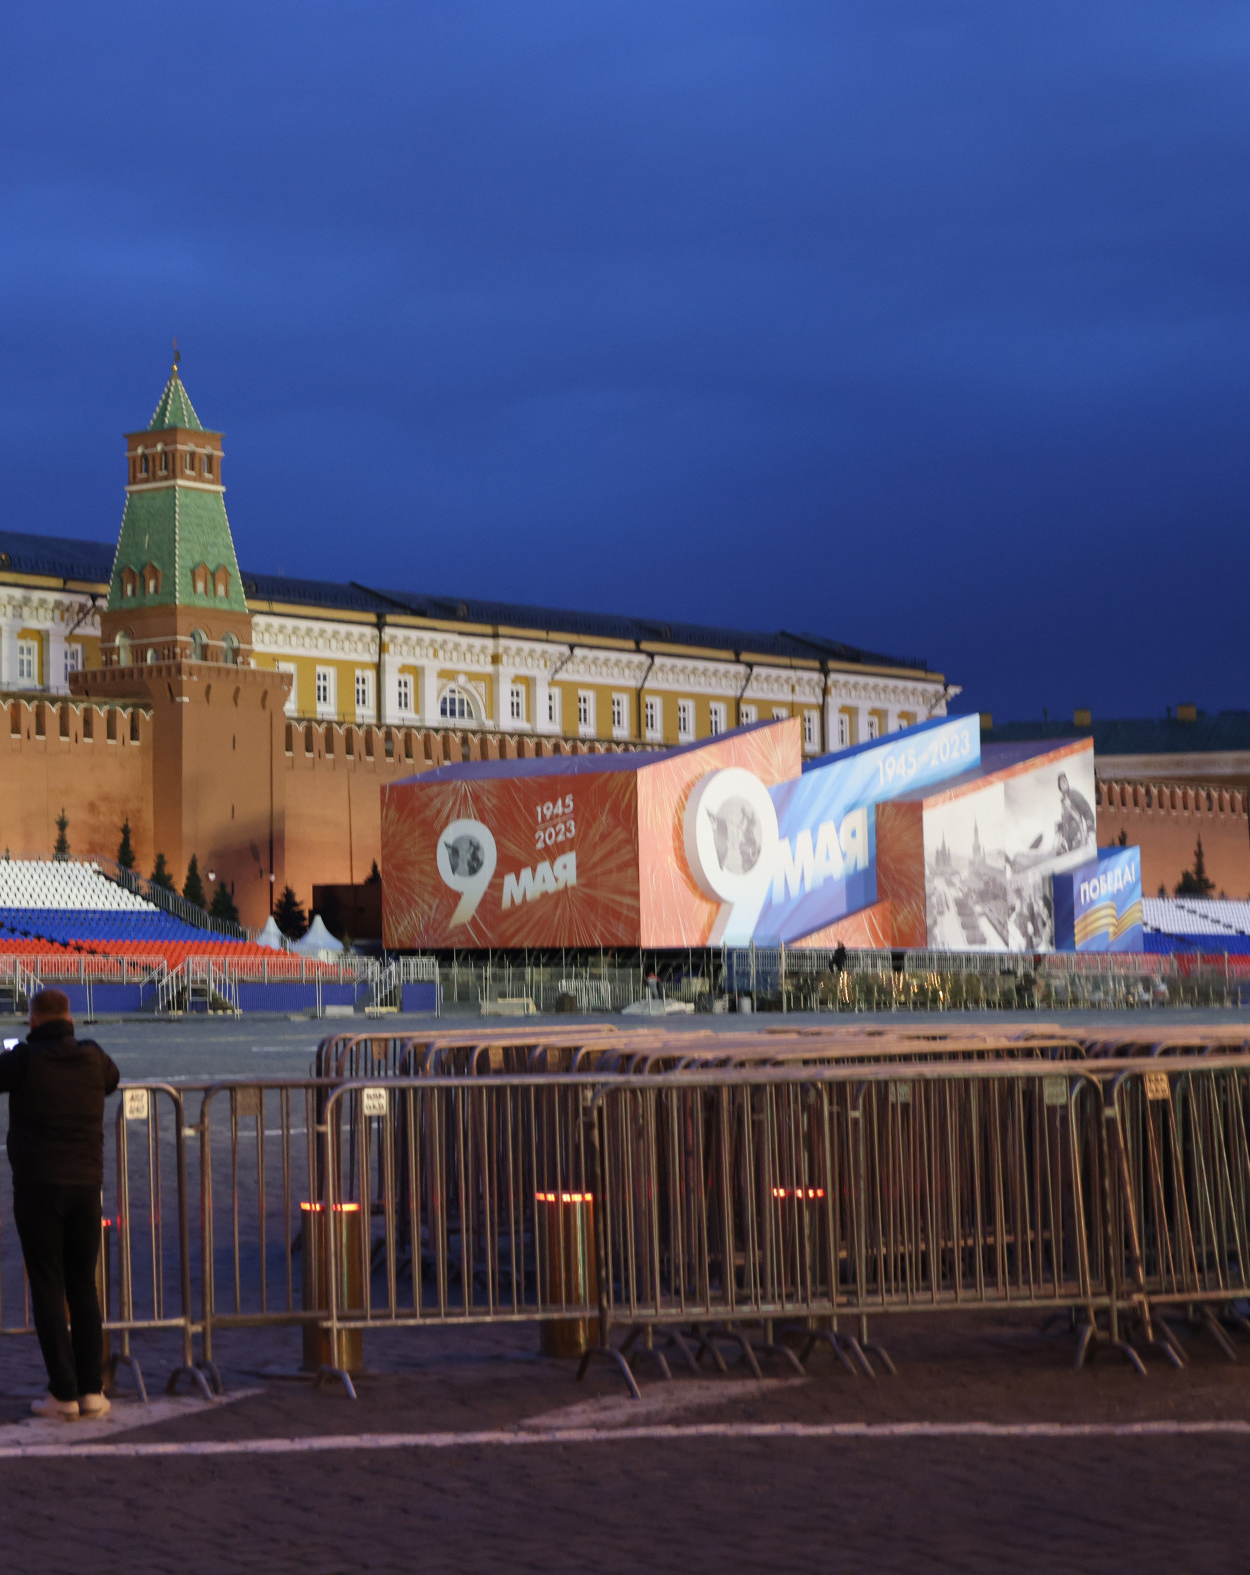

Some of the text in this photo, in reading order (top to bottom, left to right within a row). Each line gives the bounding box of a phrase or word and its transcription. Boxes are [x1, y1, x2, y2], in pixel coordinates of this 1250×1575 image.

[535, 793, 574, 824] 1945
[534, 819, 576, 850] 2023
[683, 766, 870, 947] 9 МАЯ
[436, 818, 577, 930] 9 МАЯ
[1080, 860, 1136, 906] ПОБЕДА!
